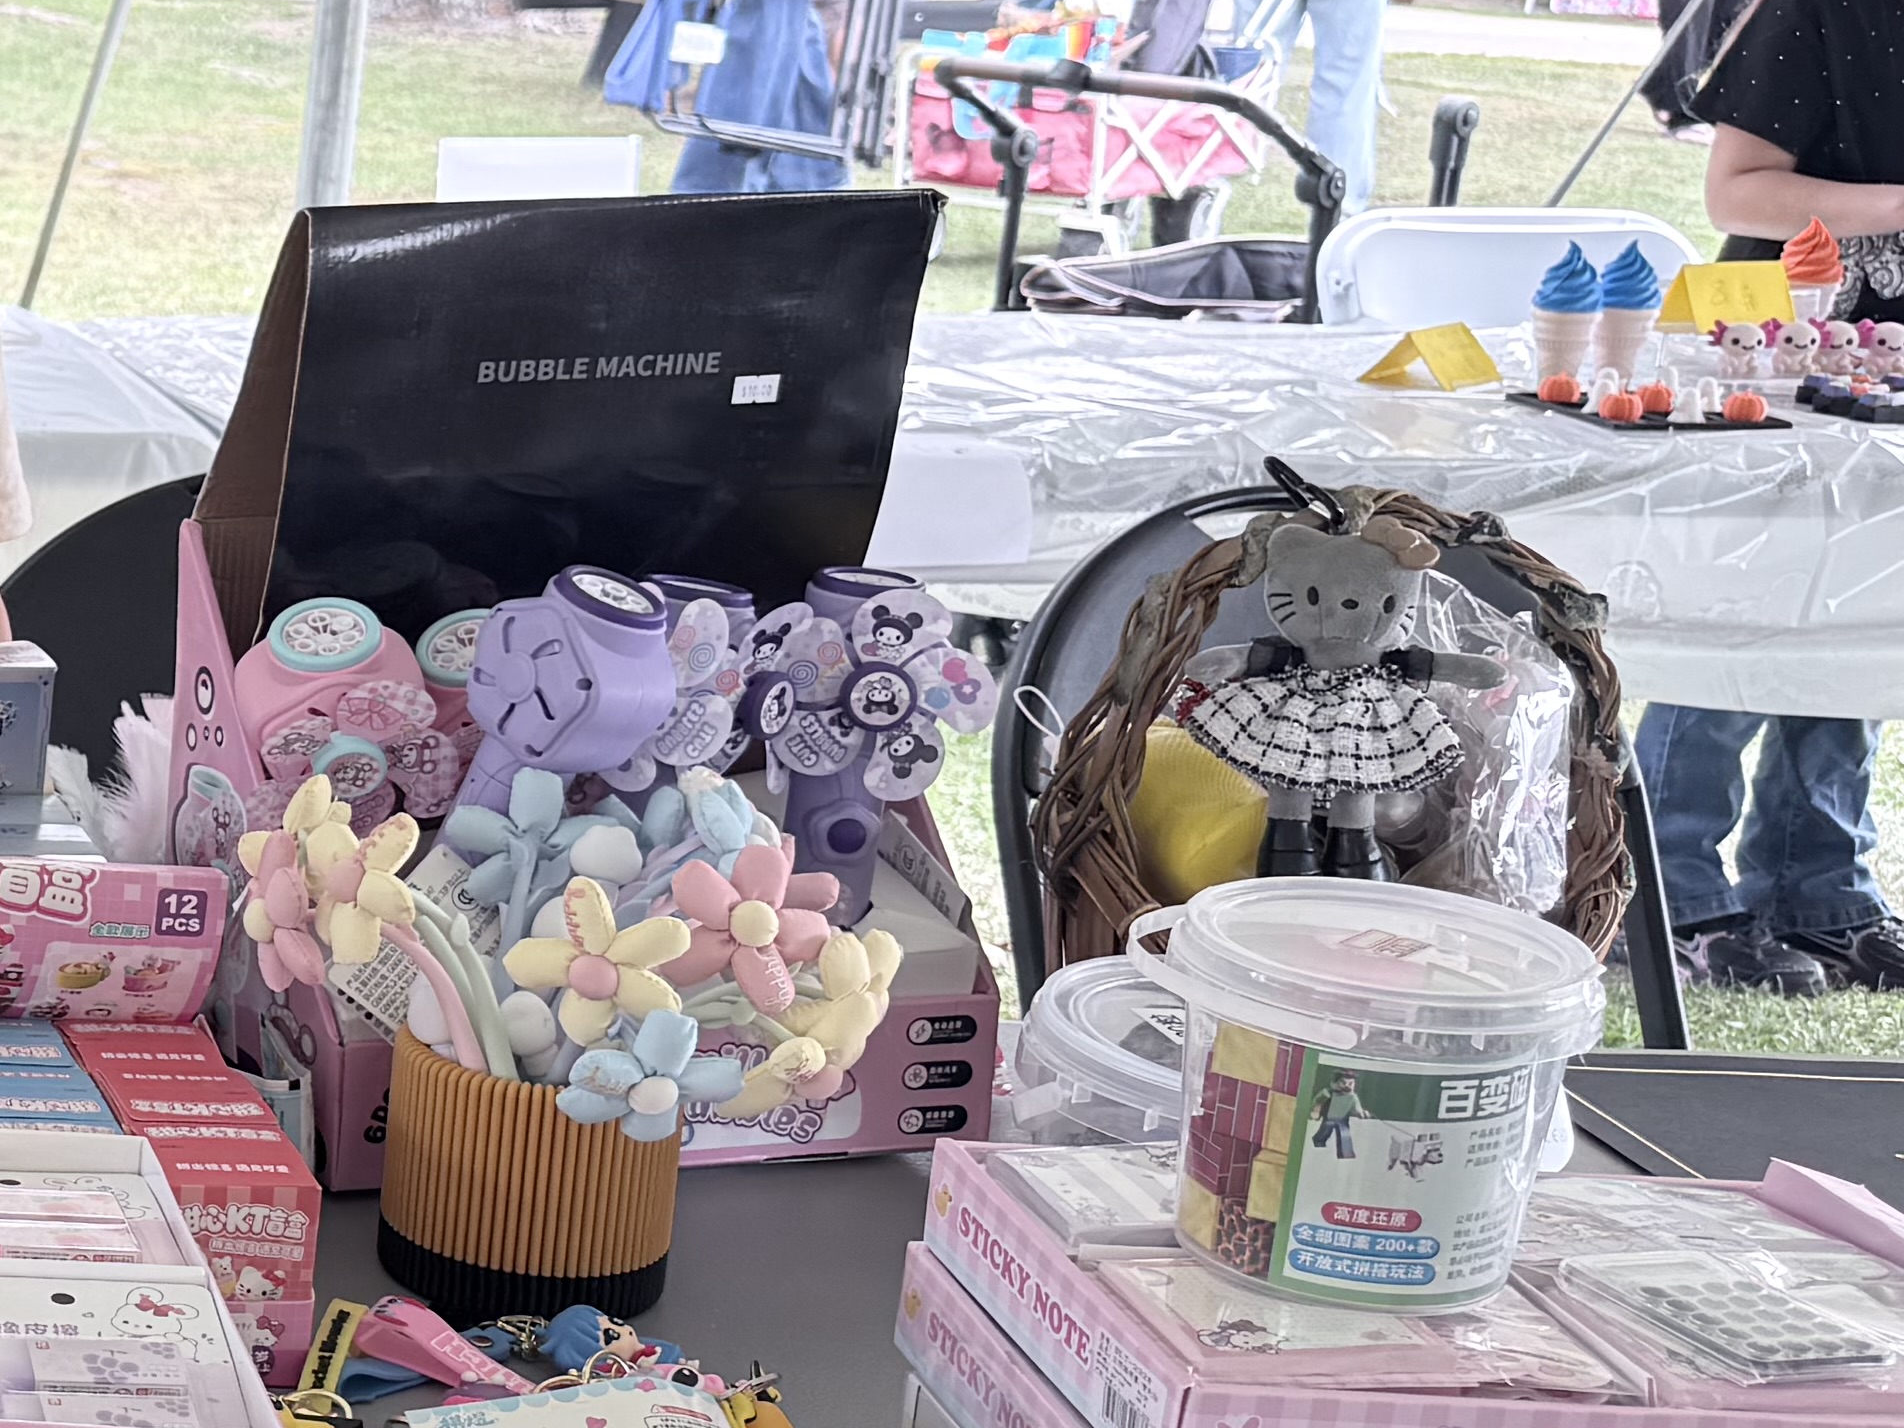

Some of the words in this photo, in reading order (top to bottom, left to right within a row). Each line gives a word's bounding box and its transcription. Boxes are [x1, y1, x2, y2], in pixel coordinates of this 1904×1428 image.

[477, 357, 590, 384] BUBBLE
[595, 351, 722, 379] MACHINE
[163, 894, 199, 916] 12
[161, 916, 202, 934] PCS
[1332, 1206, 1408, 1229] 高度还原
[958, 1206, 1032, 1301] STICKY
[1033, 1286, 1092, 1367] NOTE
[927, 1311, 996, 1411] STICKY
